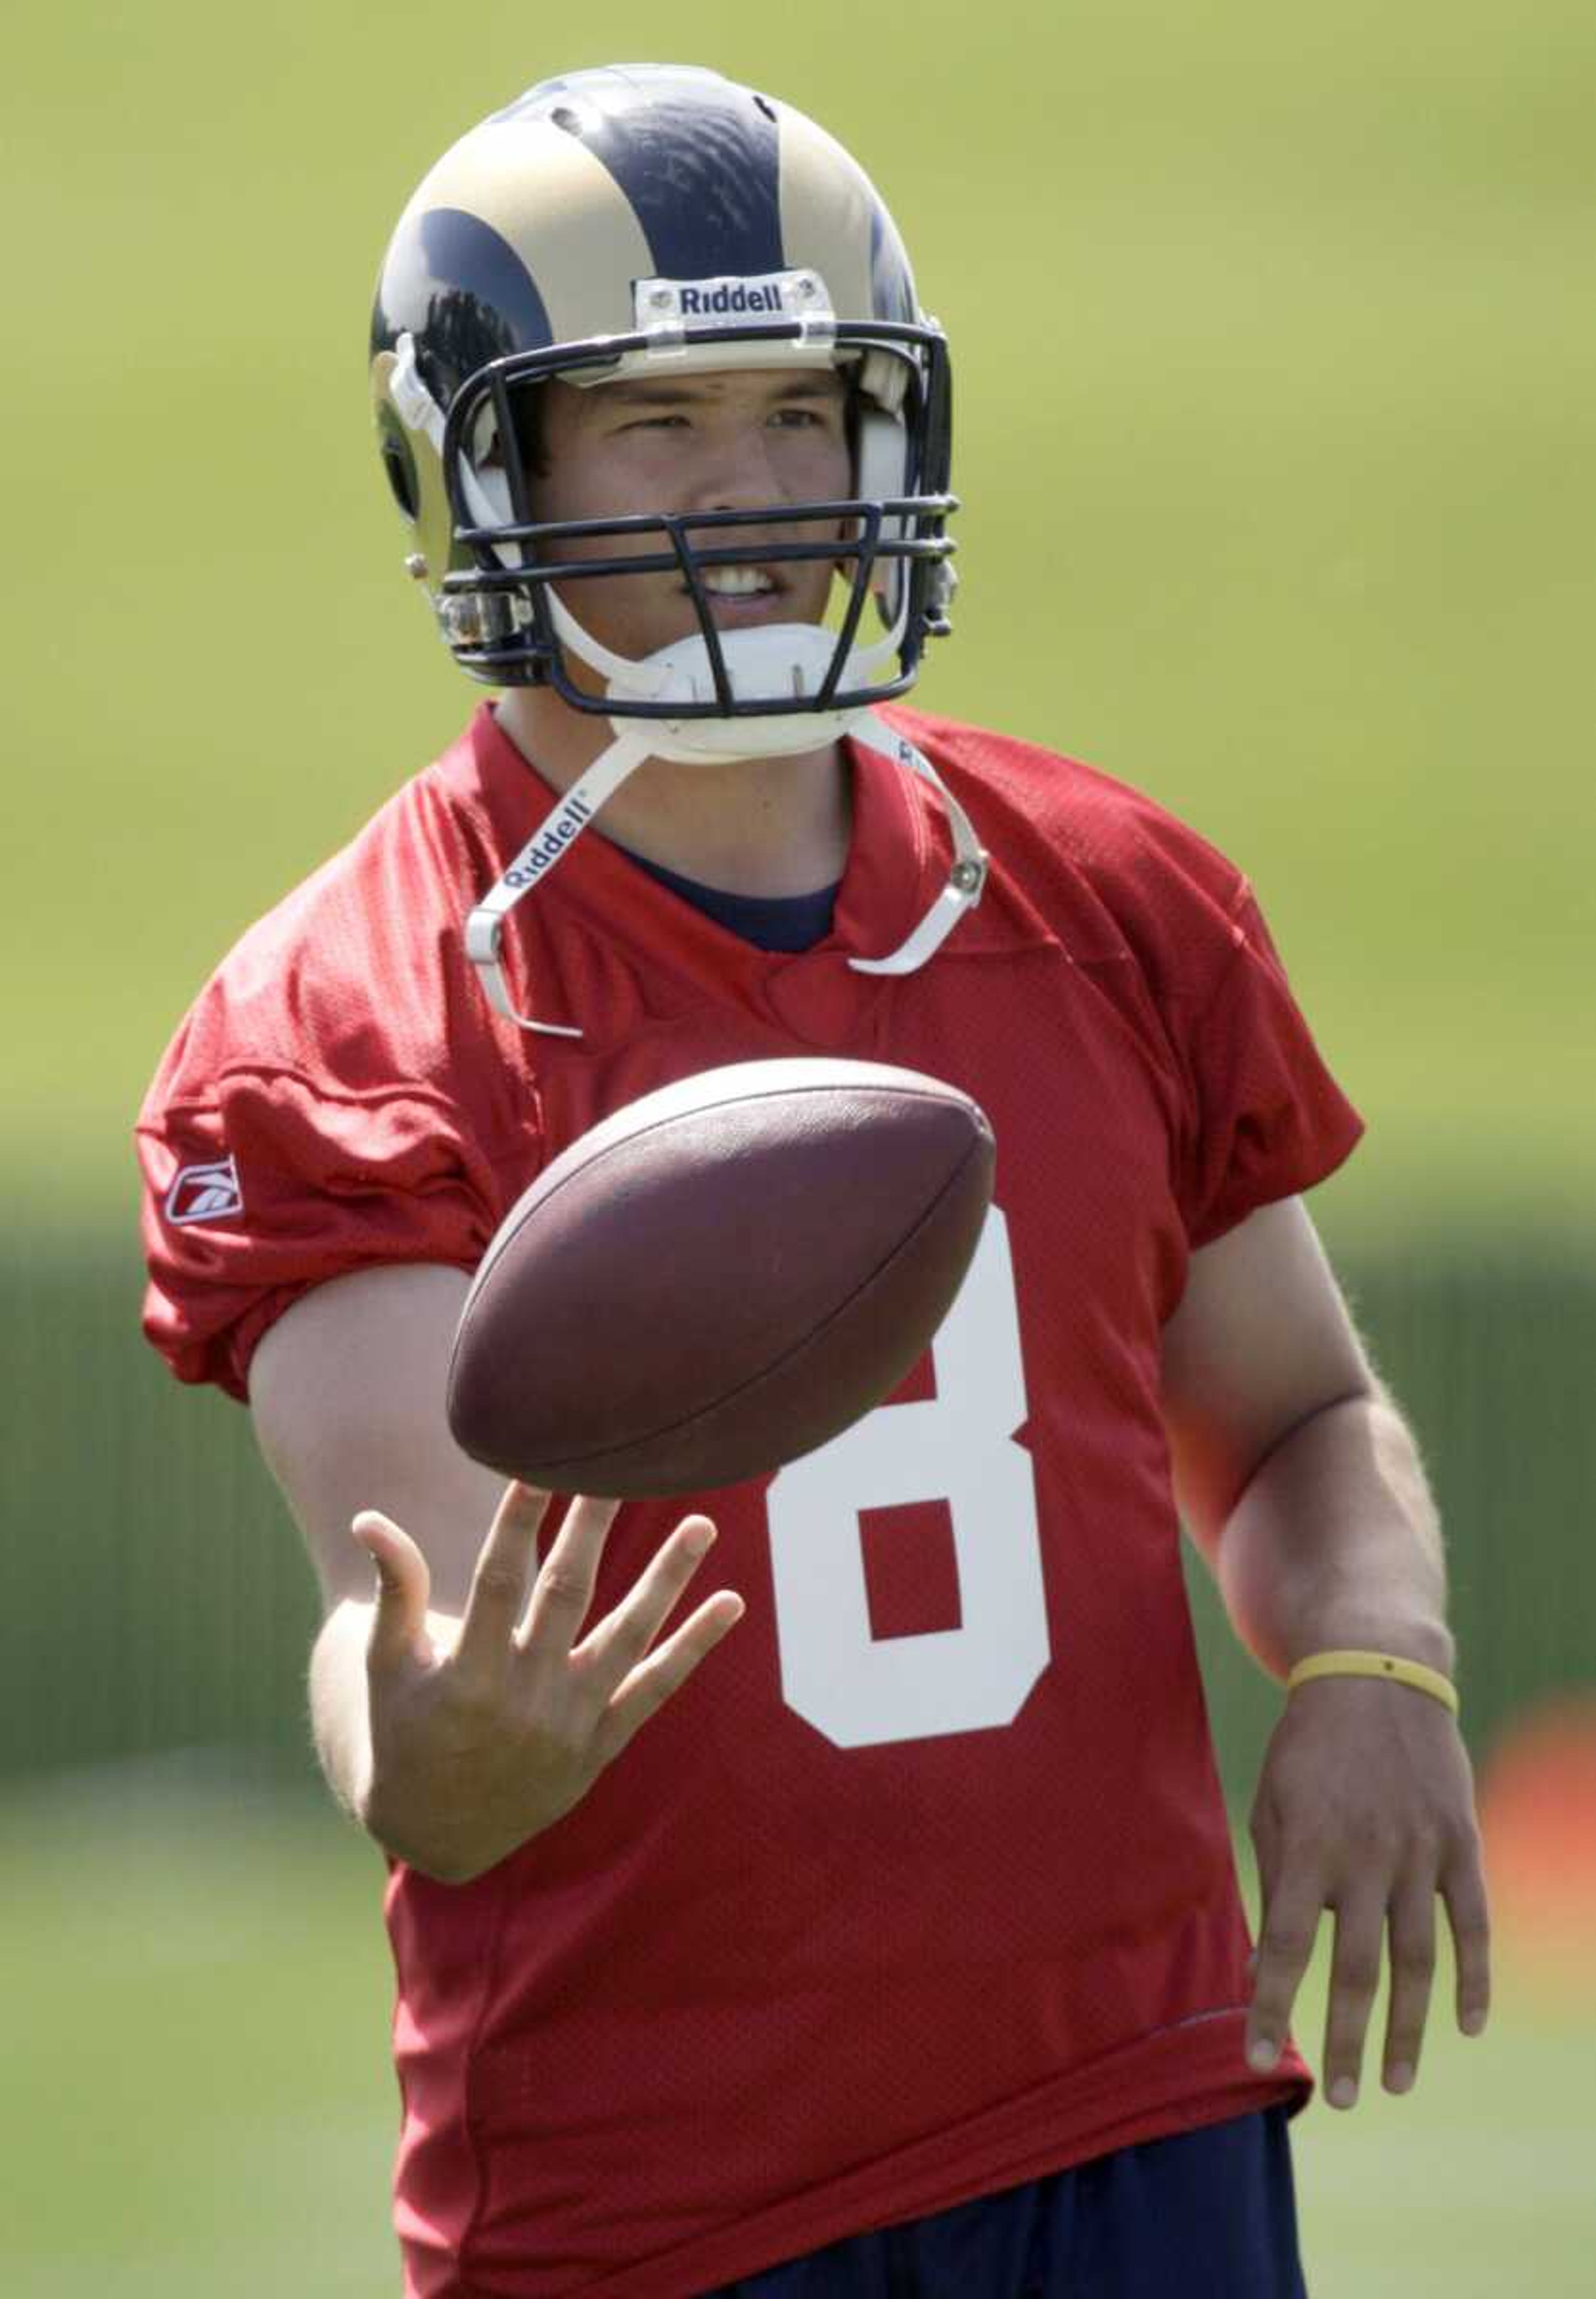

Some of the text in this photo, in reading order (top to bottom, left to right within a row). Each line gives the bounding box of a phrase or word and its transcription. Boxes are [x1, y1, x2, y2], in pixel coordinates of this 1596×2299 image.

[679, 285, 782, 314] Riddell
[503, 797, 591, 889] Riddell
[766, 1204, 1050, 1748] 8
